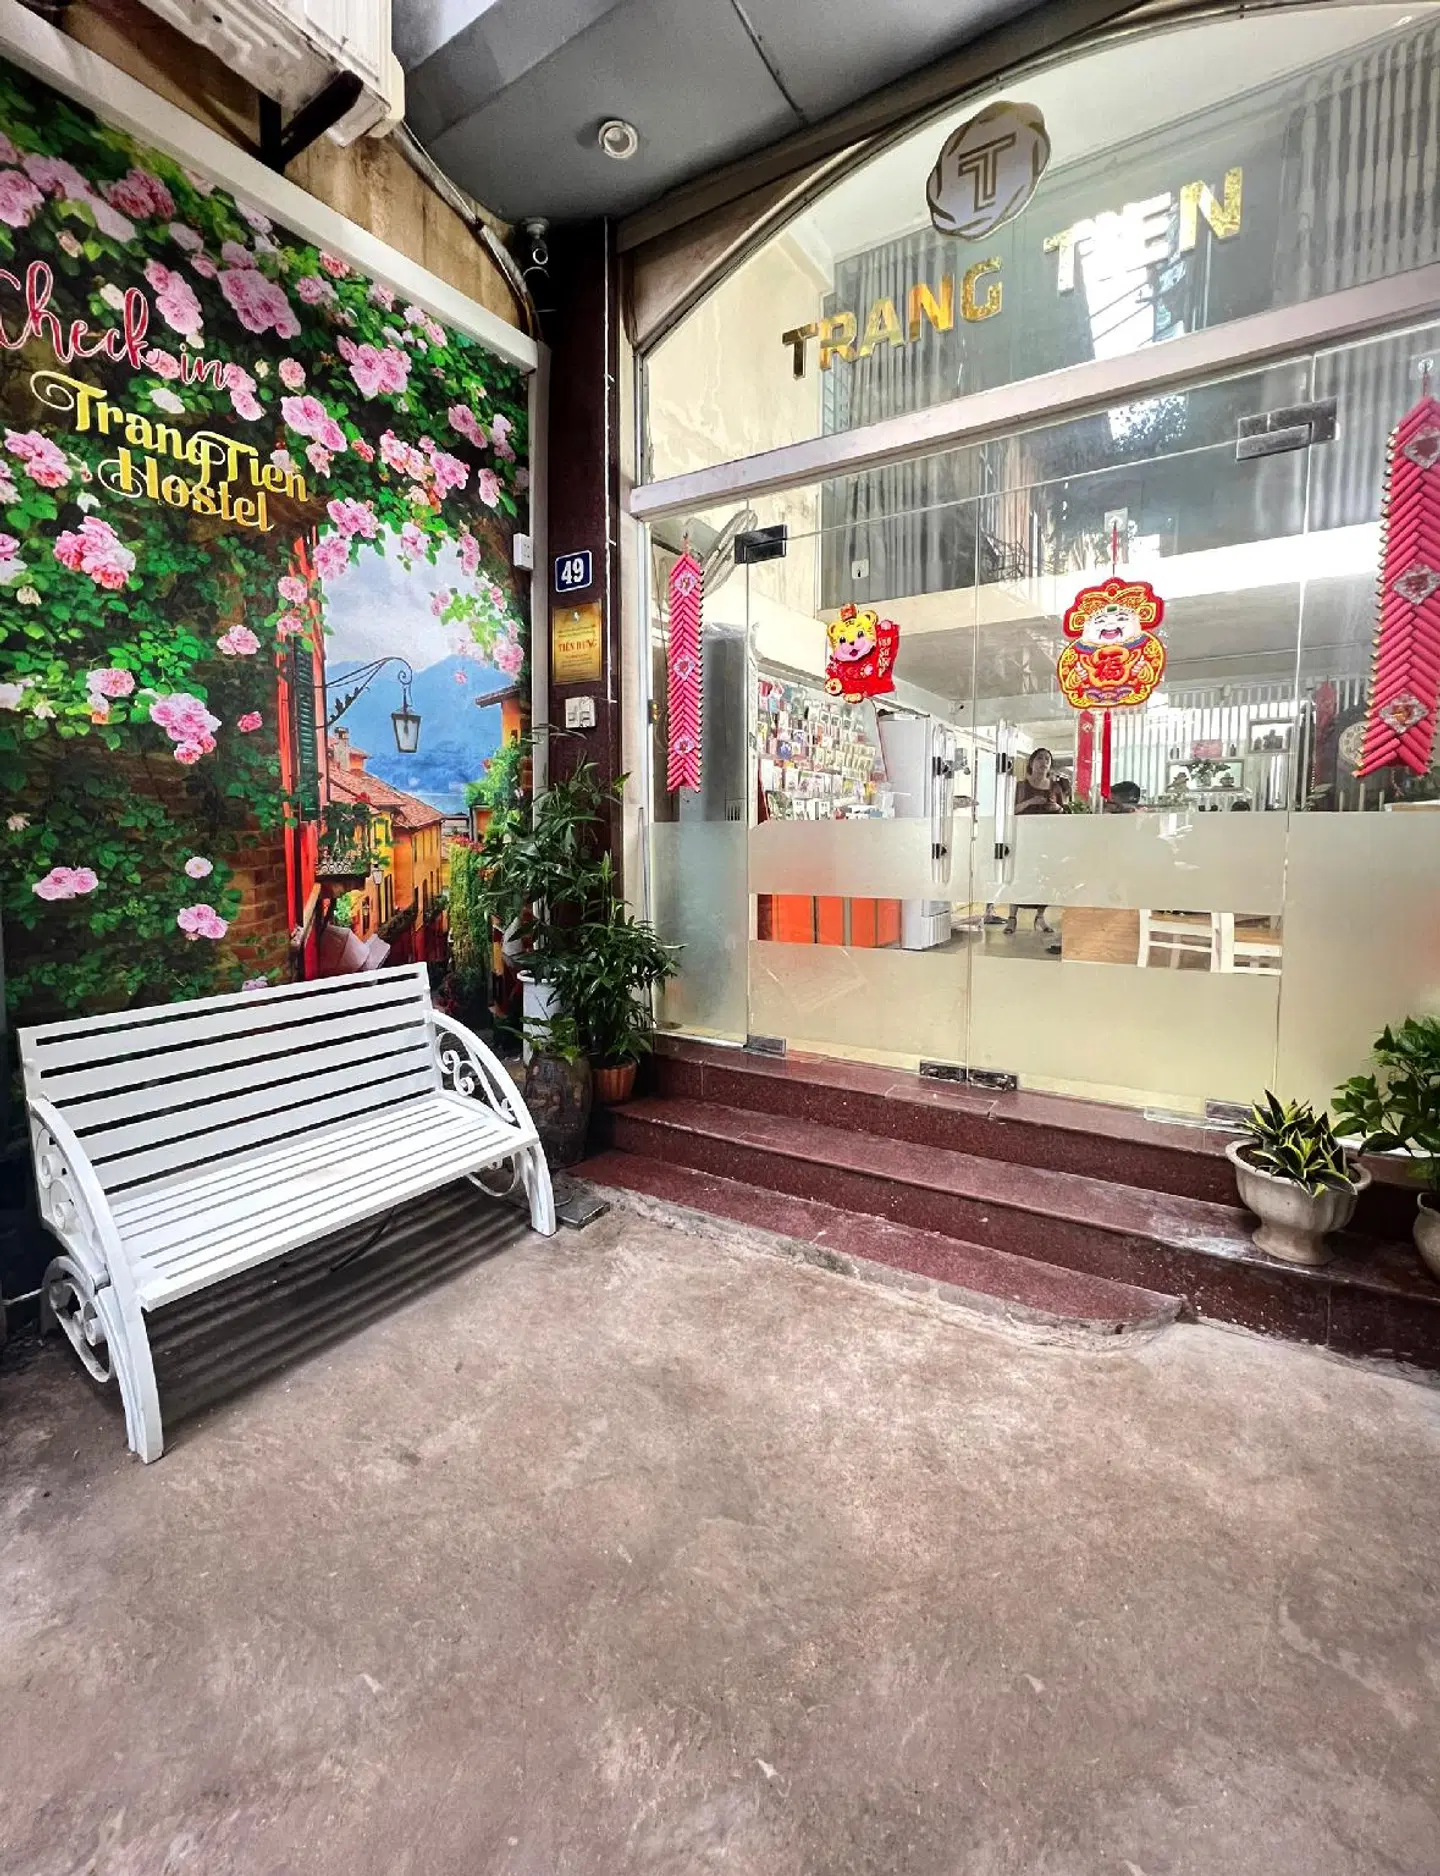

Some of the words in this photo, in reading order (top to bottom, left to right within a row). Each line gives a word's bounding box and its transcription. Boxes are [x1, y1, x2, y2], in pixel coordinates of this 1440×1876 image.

[782, 256, 1003, 380] TRANG
[1043, 166, 1243, 294] TEN
[180, 342, 228, 391] in
[97, 446, 275, 532] Hostel
[561, 558, 584, 584] 49
[1095, 655, 1126, 681] 福
